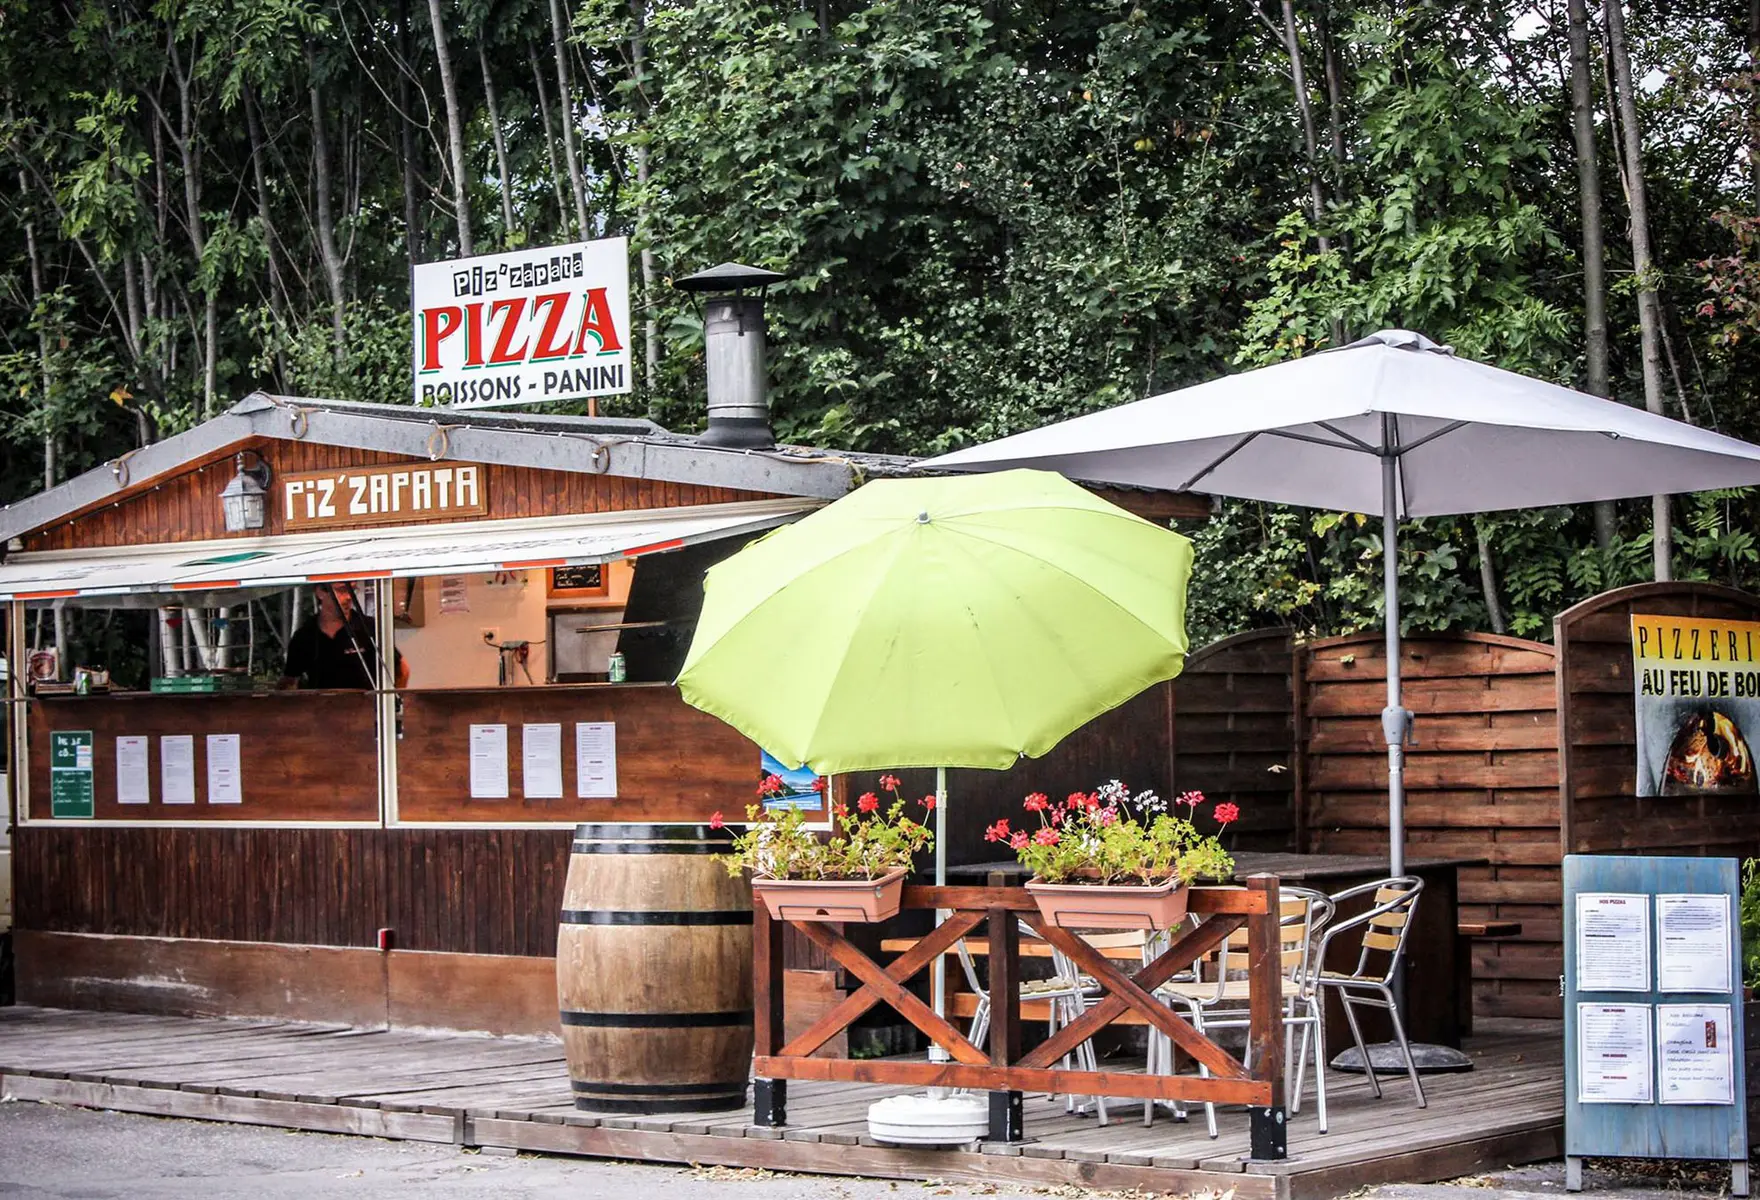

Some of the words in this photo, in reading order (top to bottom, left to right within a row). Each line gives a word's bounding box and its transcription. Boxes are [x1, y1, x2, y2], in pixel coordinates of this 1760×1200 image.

[419, 287, 623, 374] PIZZA
[422, 374, 521, 408] BOISSONS
[544, 364, 624, 395] PANINI
[1638, 626, 1760, 662] PIZZERI
[1670, 670, 1701, 697] FEU
[1707, 671, 1729, 697] DE
